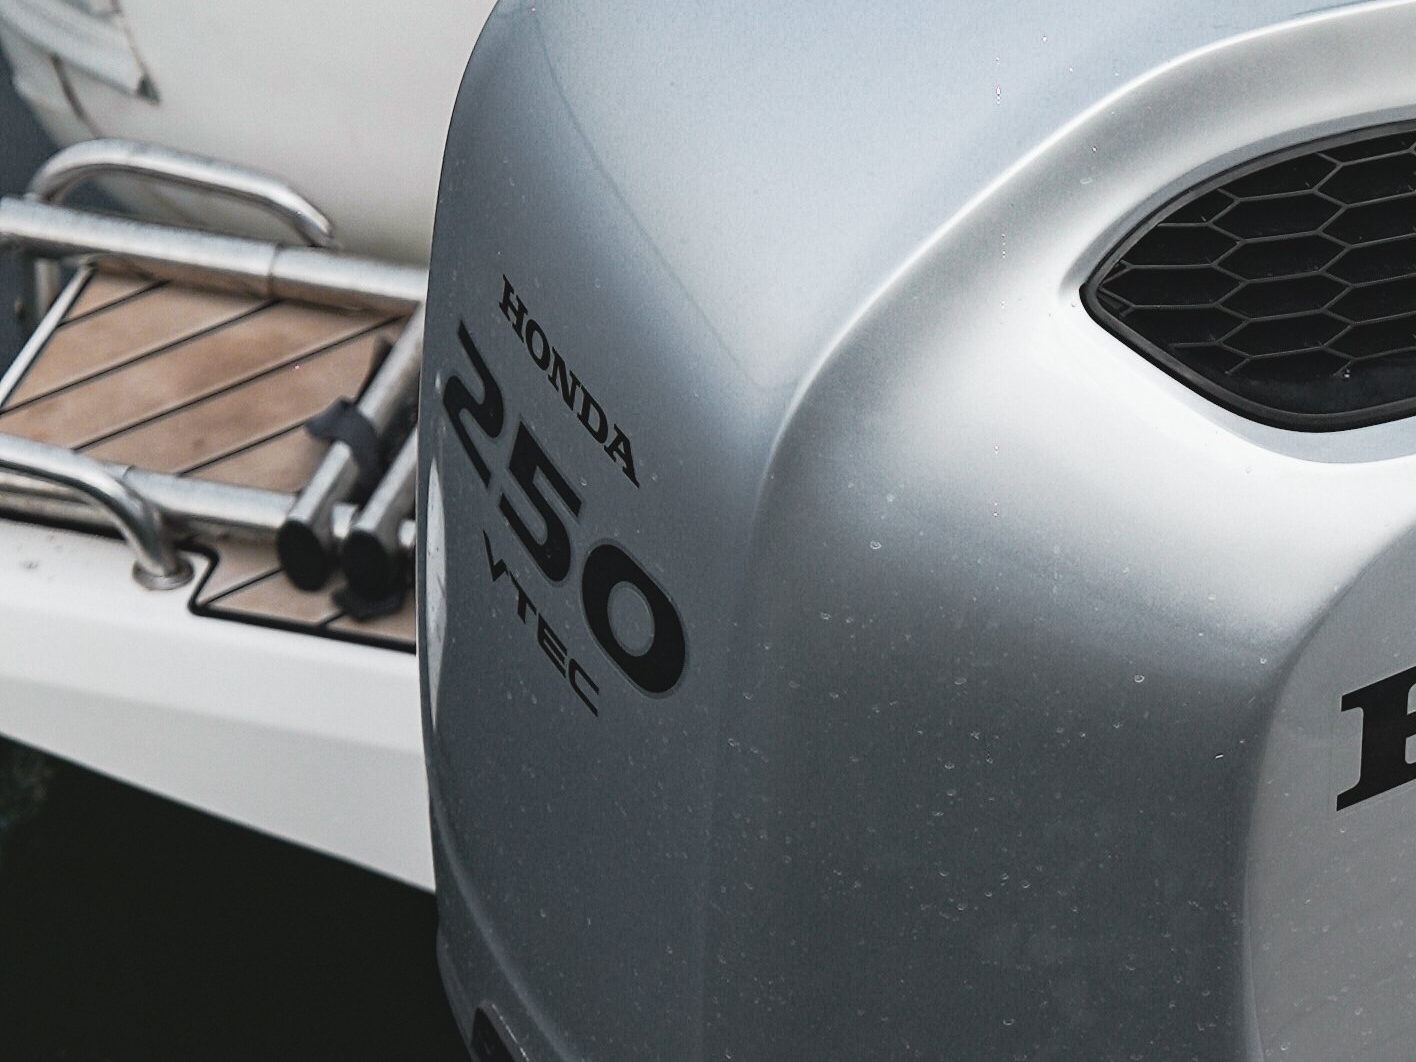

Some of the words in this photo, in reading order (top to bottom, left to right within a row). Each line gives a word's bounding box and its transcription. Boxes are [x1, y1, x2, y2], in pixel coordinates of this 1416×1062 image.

[499, 273, 641, 489] HONDA
[441, 318, 688, 698] 250
[482, 529, 600, 718] VTEC
